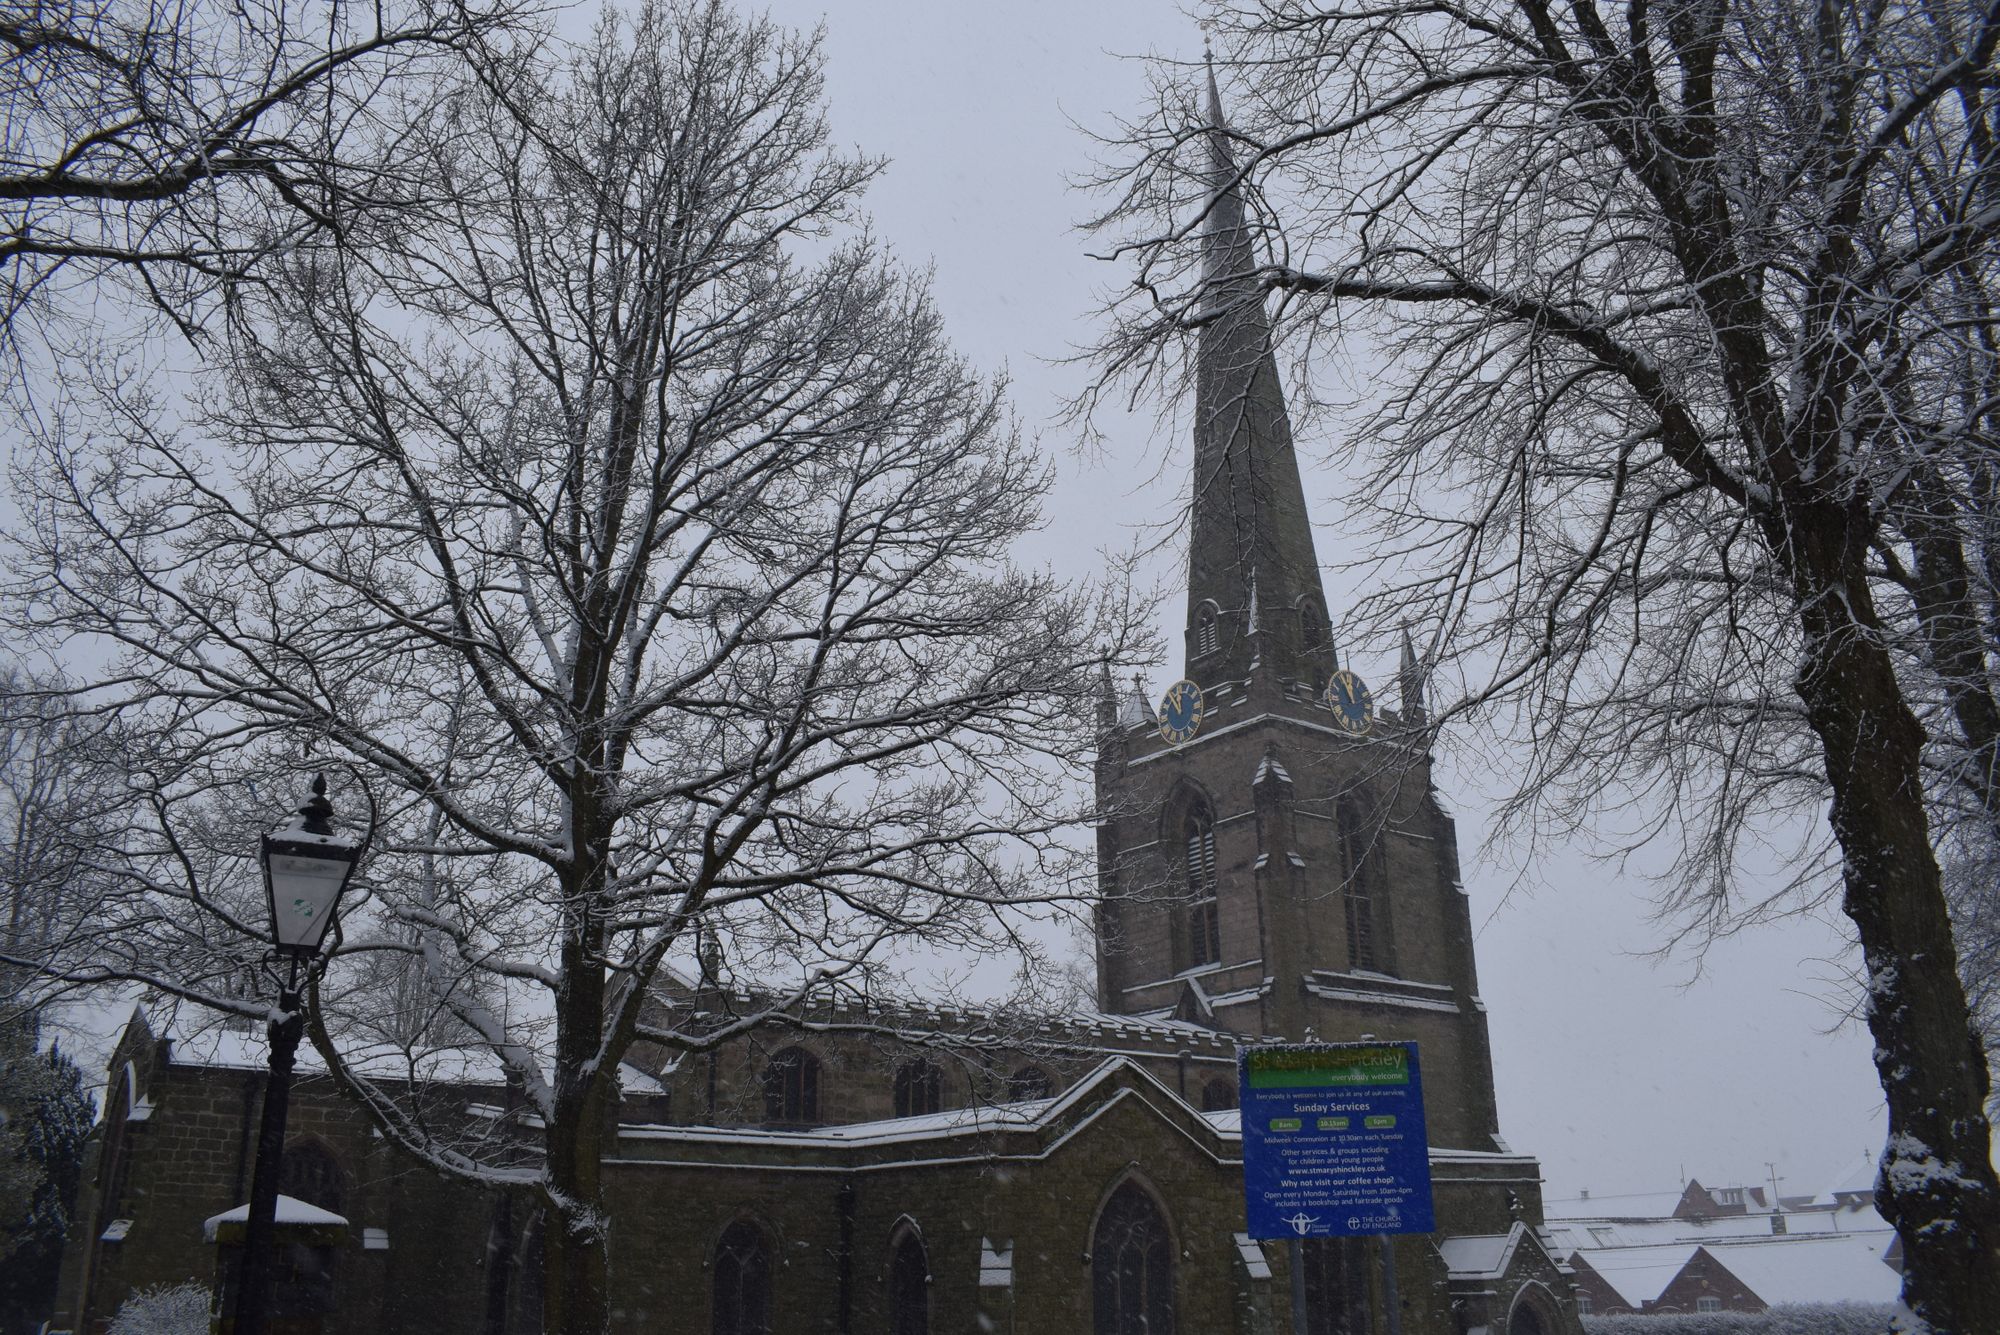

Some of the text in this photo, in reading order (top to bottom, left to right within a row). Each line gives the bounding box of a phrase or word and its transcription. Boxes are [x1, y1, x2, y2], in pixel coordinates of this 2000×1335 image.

[1331, 1072, 1403, 1081] everybody welcome
[1293, 1102, 1370, 1113] Sunday Services
[1264, 1136, 1292, 1144] Midweek
[1337, 1148, 1359, 1156] groups
[1361, 1146, 1389, 1154] including
[1299, 1157, 1325, 1165] children
[1362, 1156, 1384, 1164] people
[1288, 1165, 1386, 1175] www.stmaryshinckley.co.uk
[1280, 1179, 1298, 1188] Why
[1299, 1179, 1313, 1187] not
[1315, 1178, 1331, 1186] visit
[1347, 1177, 1371, 1185] coffee
[1373, 1175, 1395, 1184] shop?
[1264, 1191, 1282, 1199] Open
[1283, 1191, 1301, 1199] every
[1332, 1189, 1360, 1197] Saturday
[1275, 1199, 1301, 1207] includes
[1308, 1198, 1339, 1206] bookshop
[1384, 1196, 1403, 1204] goods
